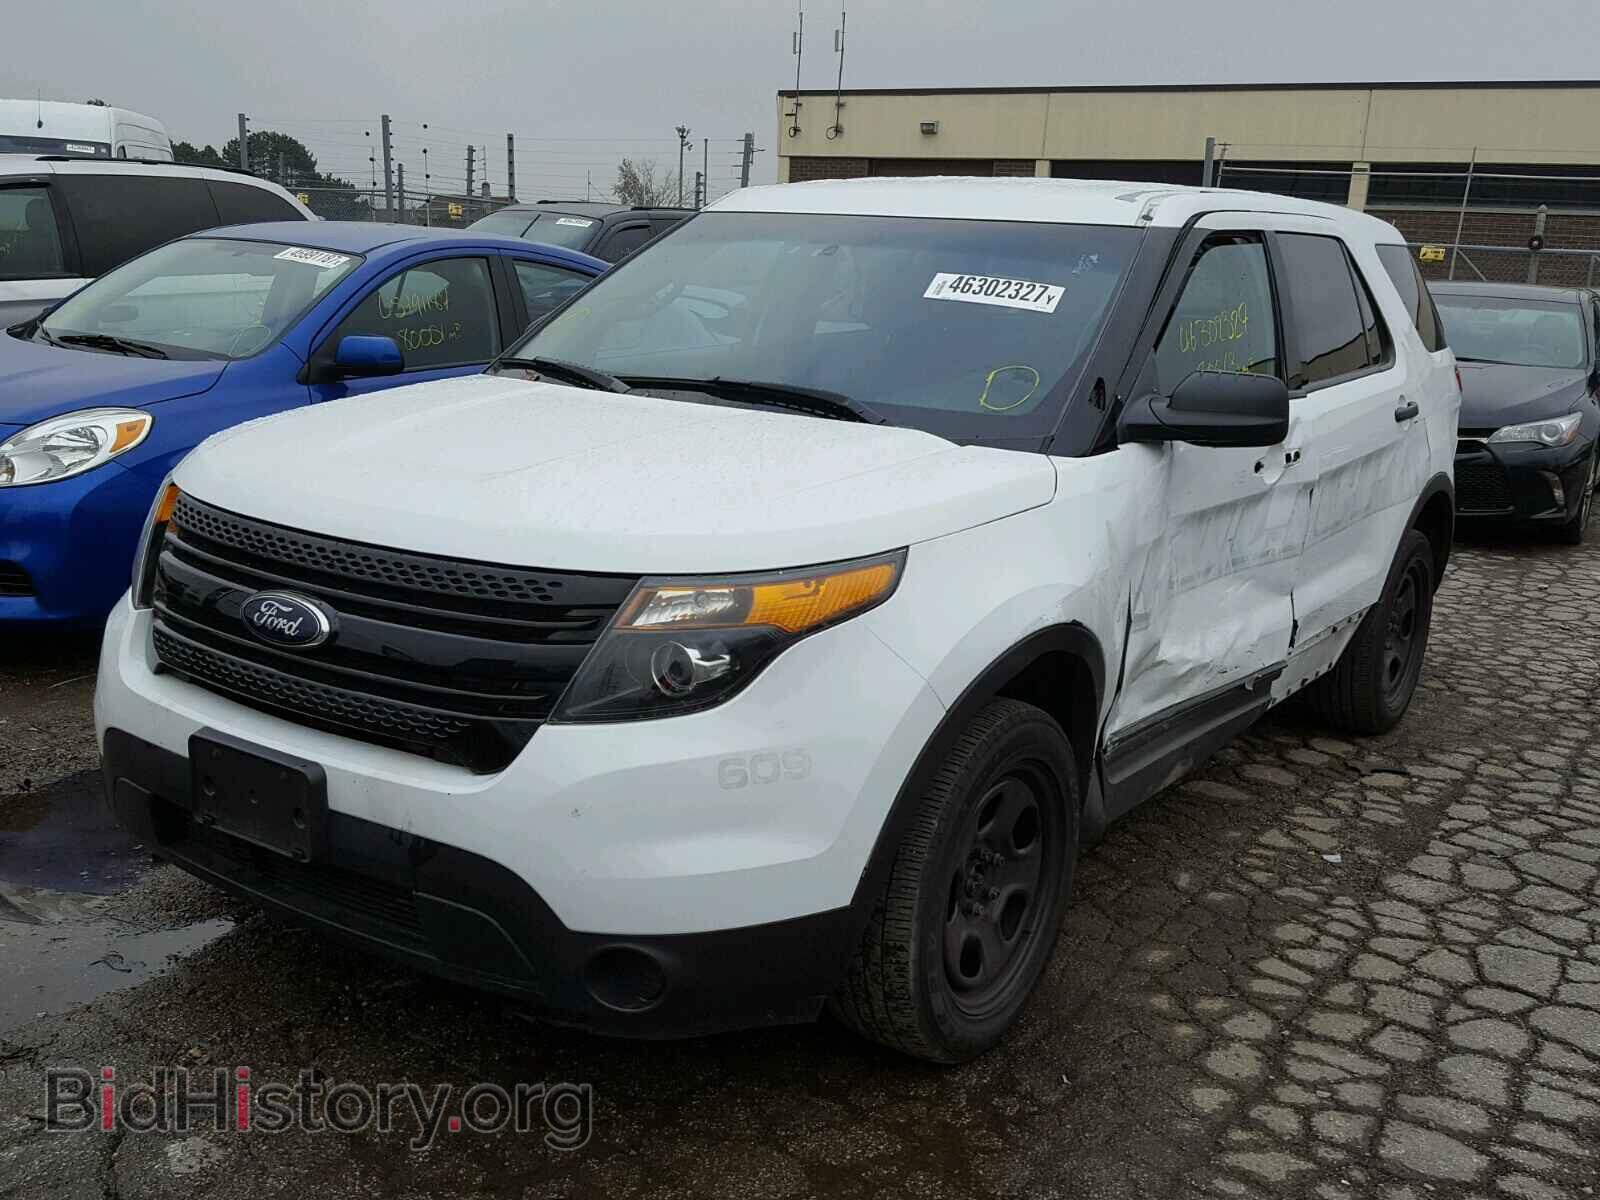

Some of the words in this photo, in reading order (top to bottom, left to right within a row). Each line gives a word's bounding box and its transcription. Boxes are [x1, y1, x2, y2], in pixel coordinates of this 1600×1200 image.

[949, 276, 1050, 302] 46302327
[253, 600, 304, 636] Ford
[718, 750, 812, 790] 609
